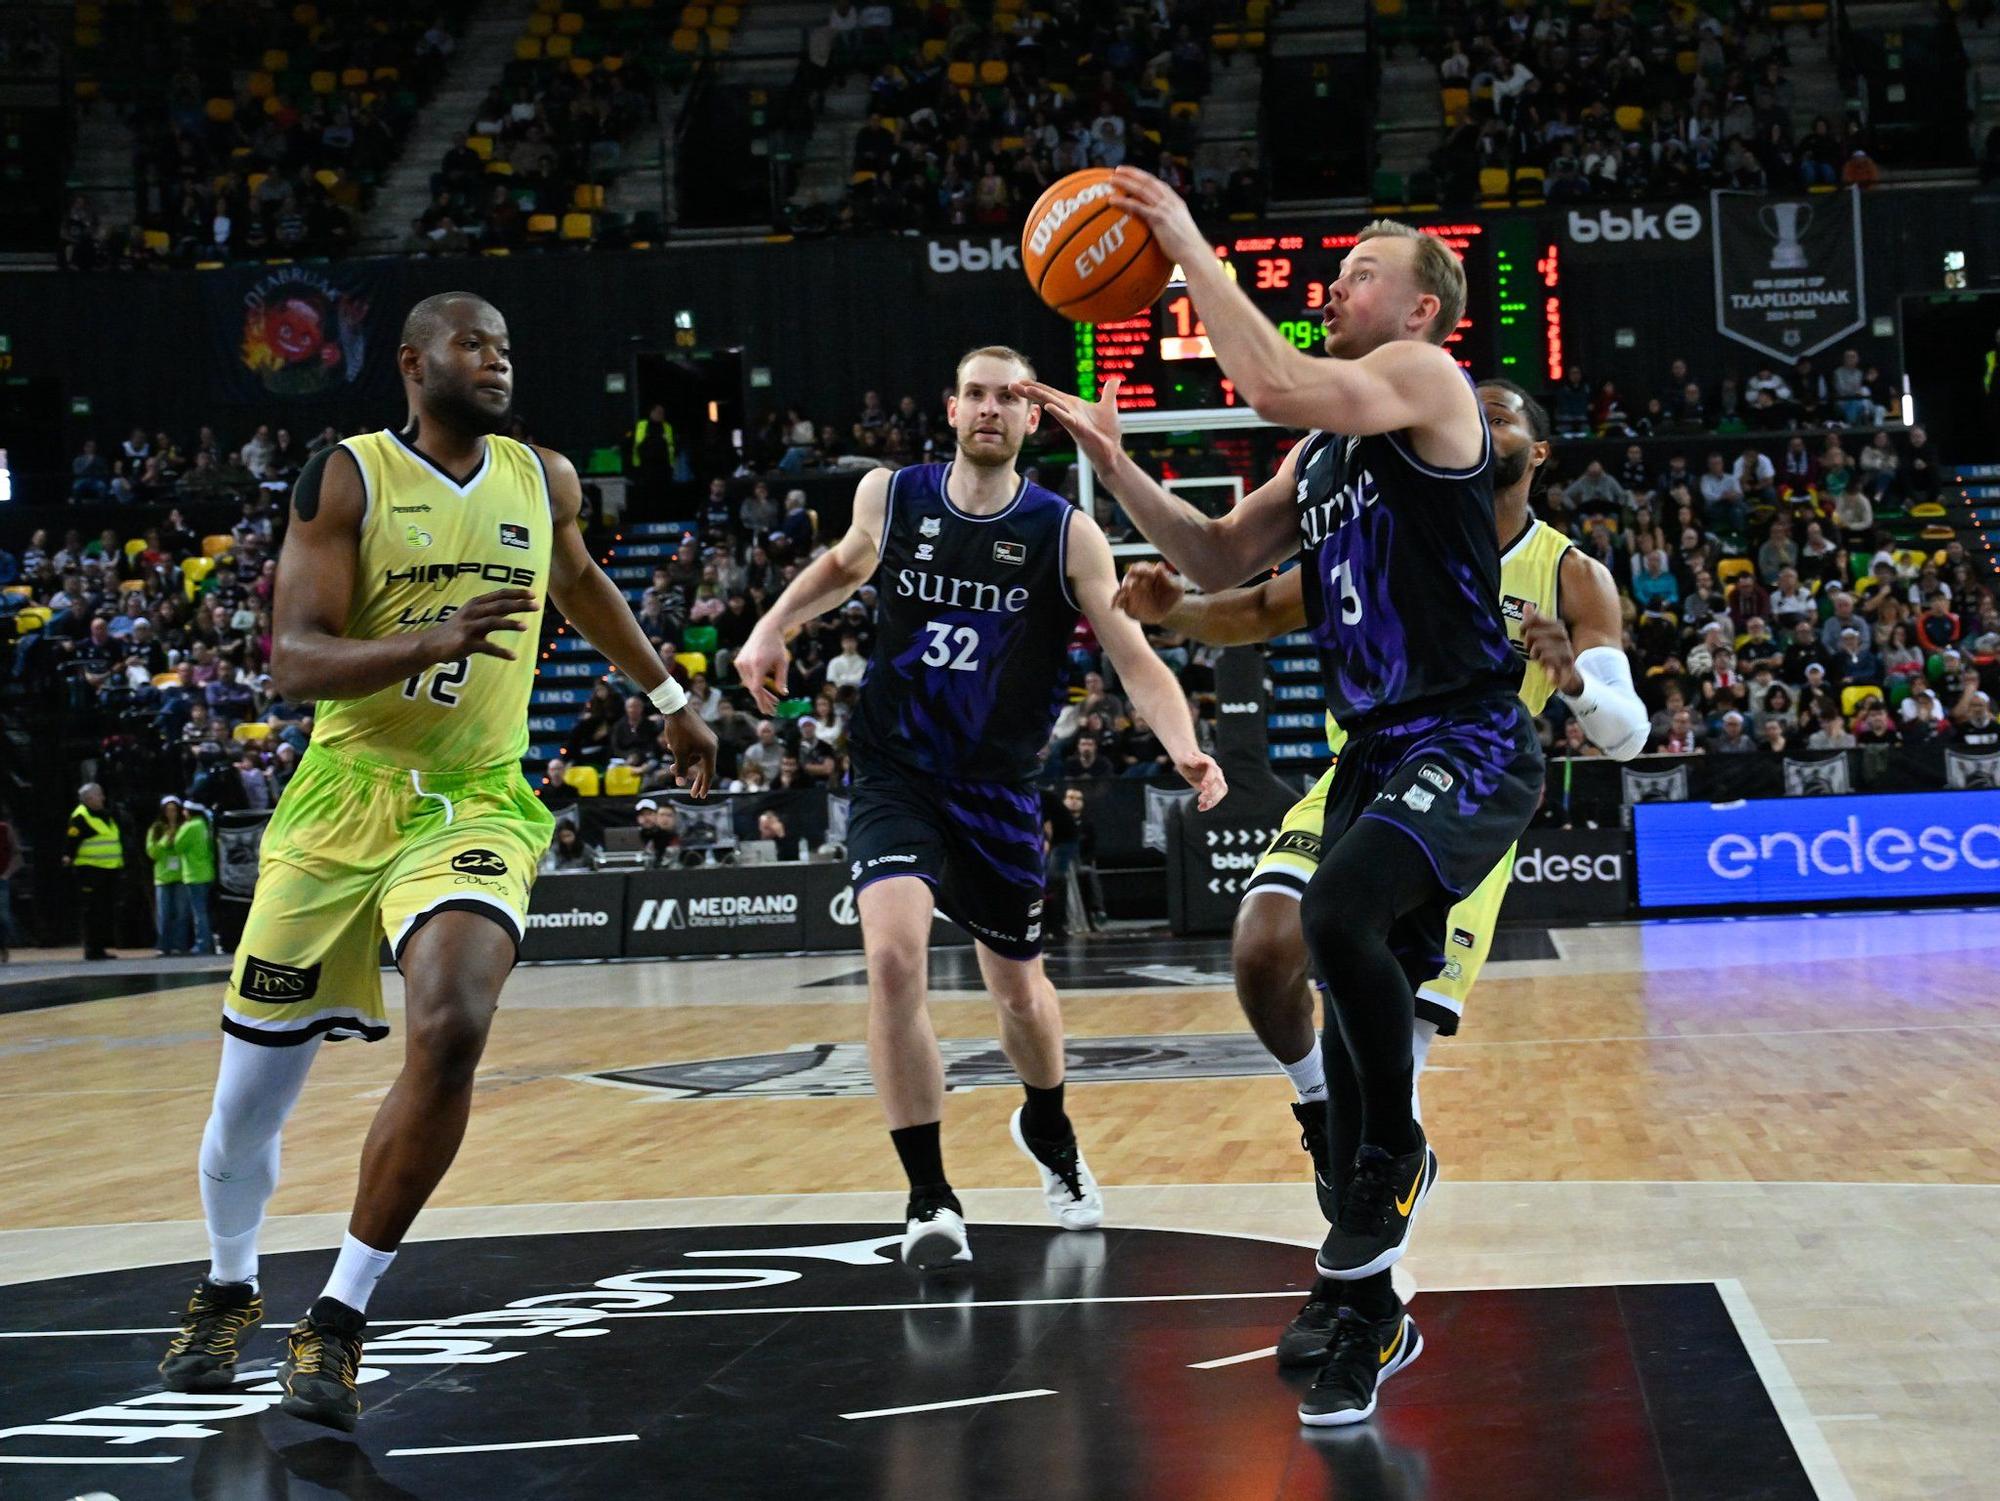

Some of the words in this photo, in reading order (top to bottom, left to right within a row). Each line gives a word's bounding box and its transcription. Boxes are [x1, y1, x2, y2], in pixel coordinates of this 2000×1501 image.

[1029, 182, 1115, 256] Wilson
[1568, 207, 1662, 243] bbk
[928, 238, 1021, 273] bbk
[1256, 258, 1291, 289] 32
[1307, 282, 1323, 308] 3
[1731, 290, 1850, 309] TXAPELDUNAK
[1168, 296, 1206, 336] 1
[896, 568, 1030, 613] surne
[1331, 559, 1364, 626] 3
[399, 605, 458, 625] LLE
[921, 621, 980, 672] 32
[556, 663, 591, 676] IMQ
[540, 690, 575, 703] IMQ
[1277, 713, 1315, 727] IMQ
[1274, 743, 1313, 758] IMQ
[1284, 834, 1322, 854] PON
[1211, 852, 1256, 870] bbk
[1513, 848, 1622, 883] desa
[688, 894, 798, 916] MEDRANO
[689, 915, 726, 927] Obras
[738, 912, 797, 926] Servicios
[251, 969, 305, 993] PONS
